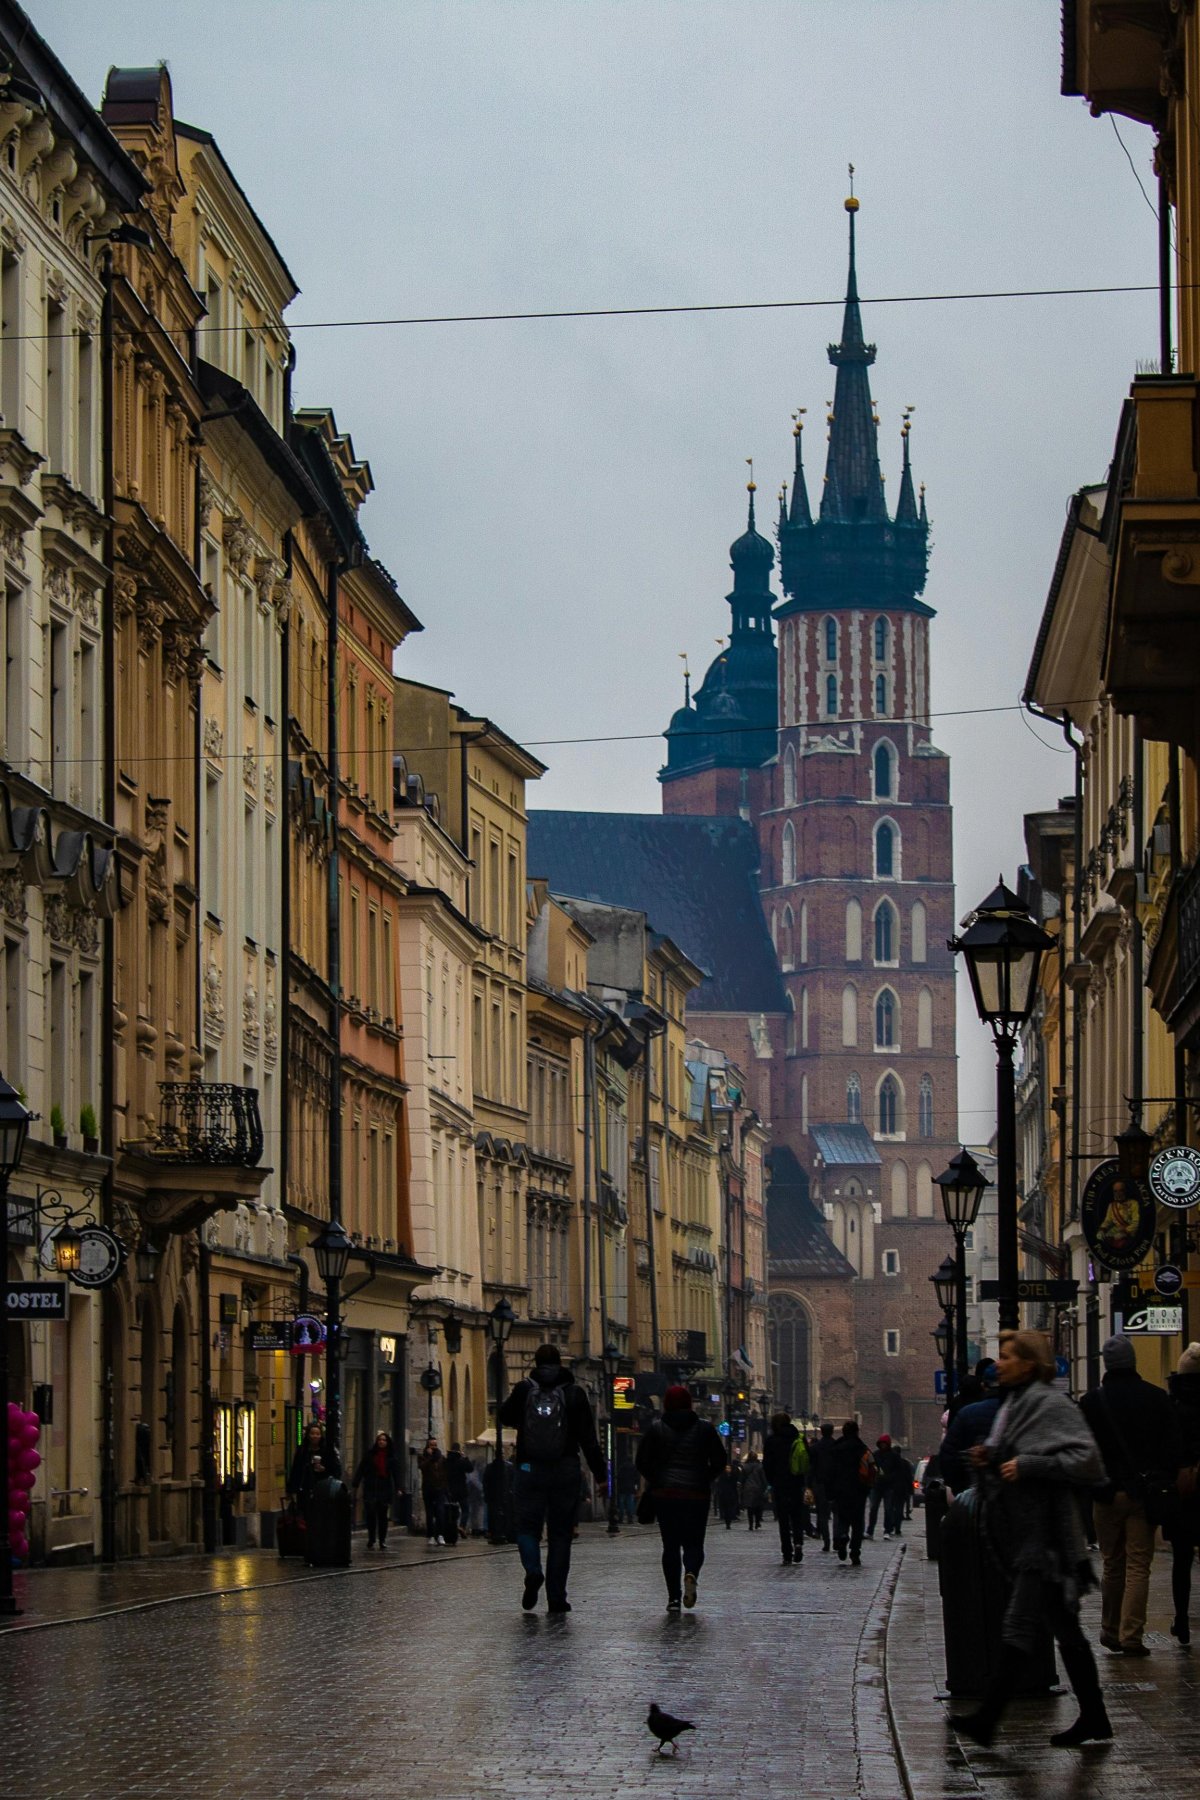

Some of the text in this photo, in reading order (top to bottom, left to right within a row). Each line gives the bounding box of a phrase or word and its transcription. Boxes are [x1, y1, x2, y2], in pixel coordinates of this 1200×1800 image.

[1155, 1185, 1179, 1204] TATTOO
[1018, 1283, 1051, 1296] OTEL
[6, 1293, 62, 1308] OSTEL
